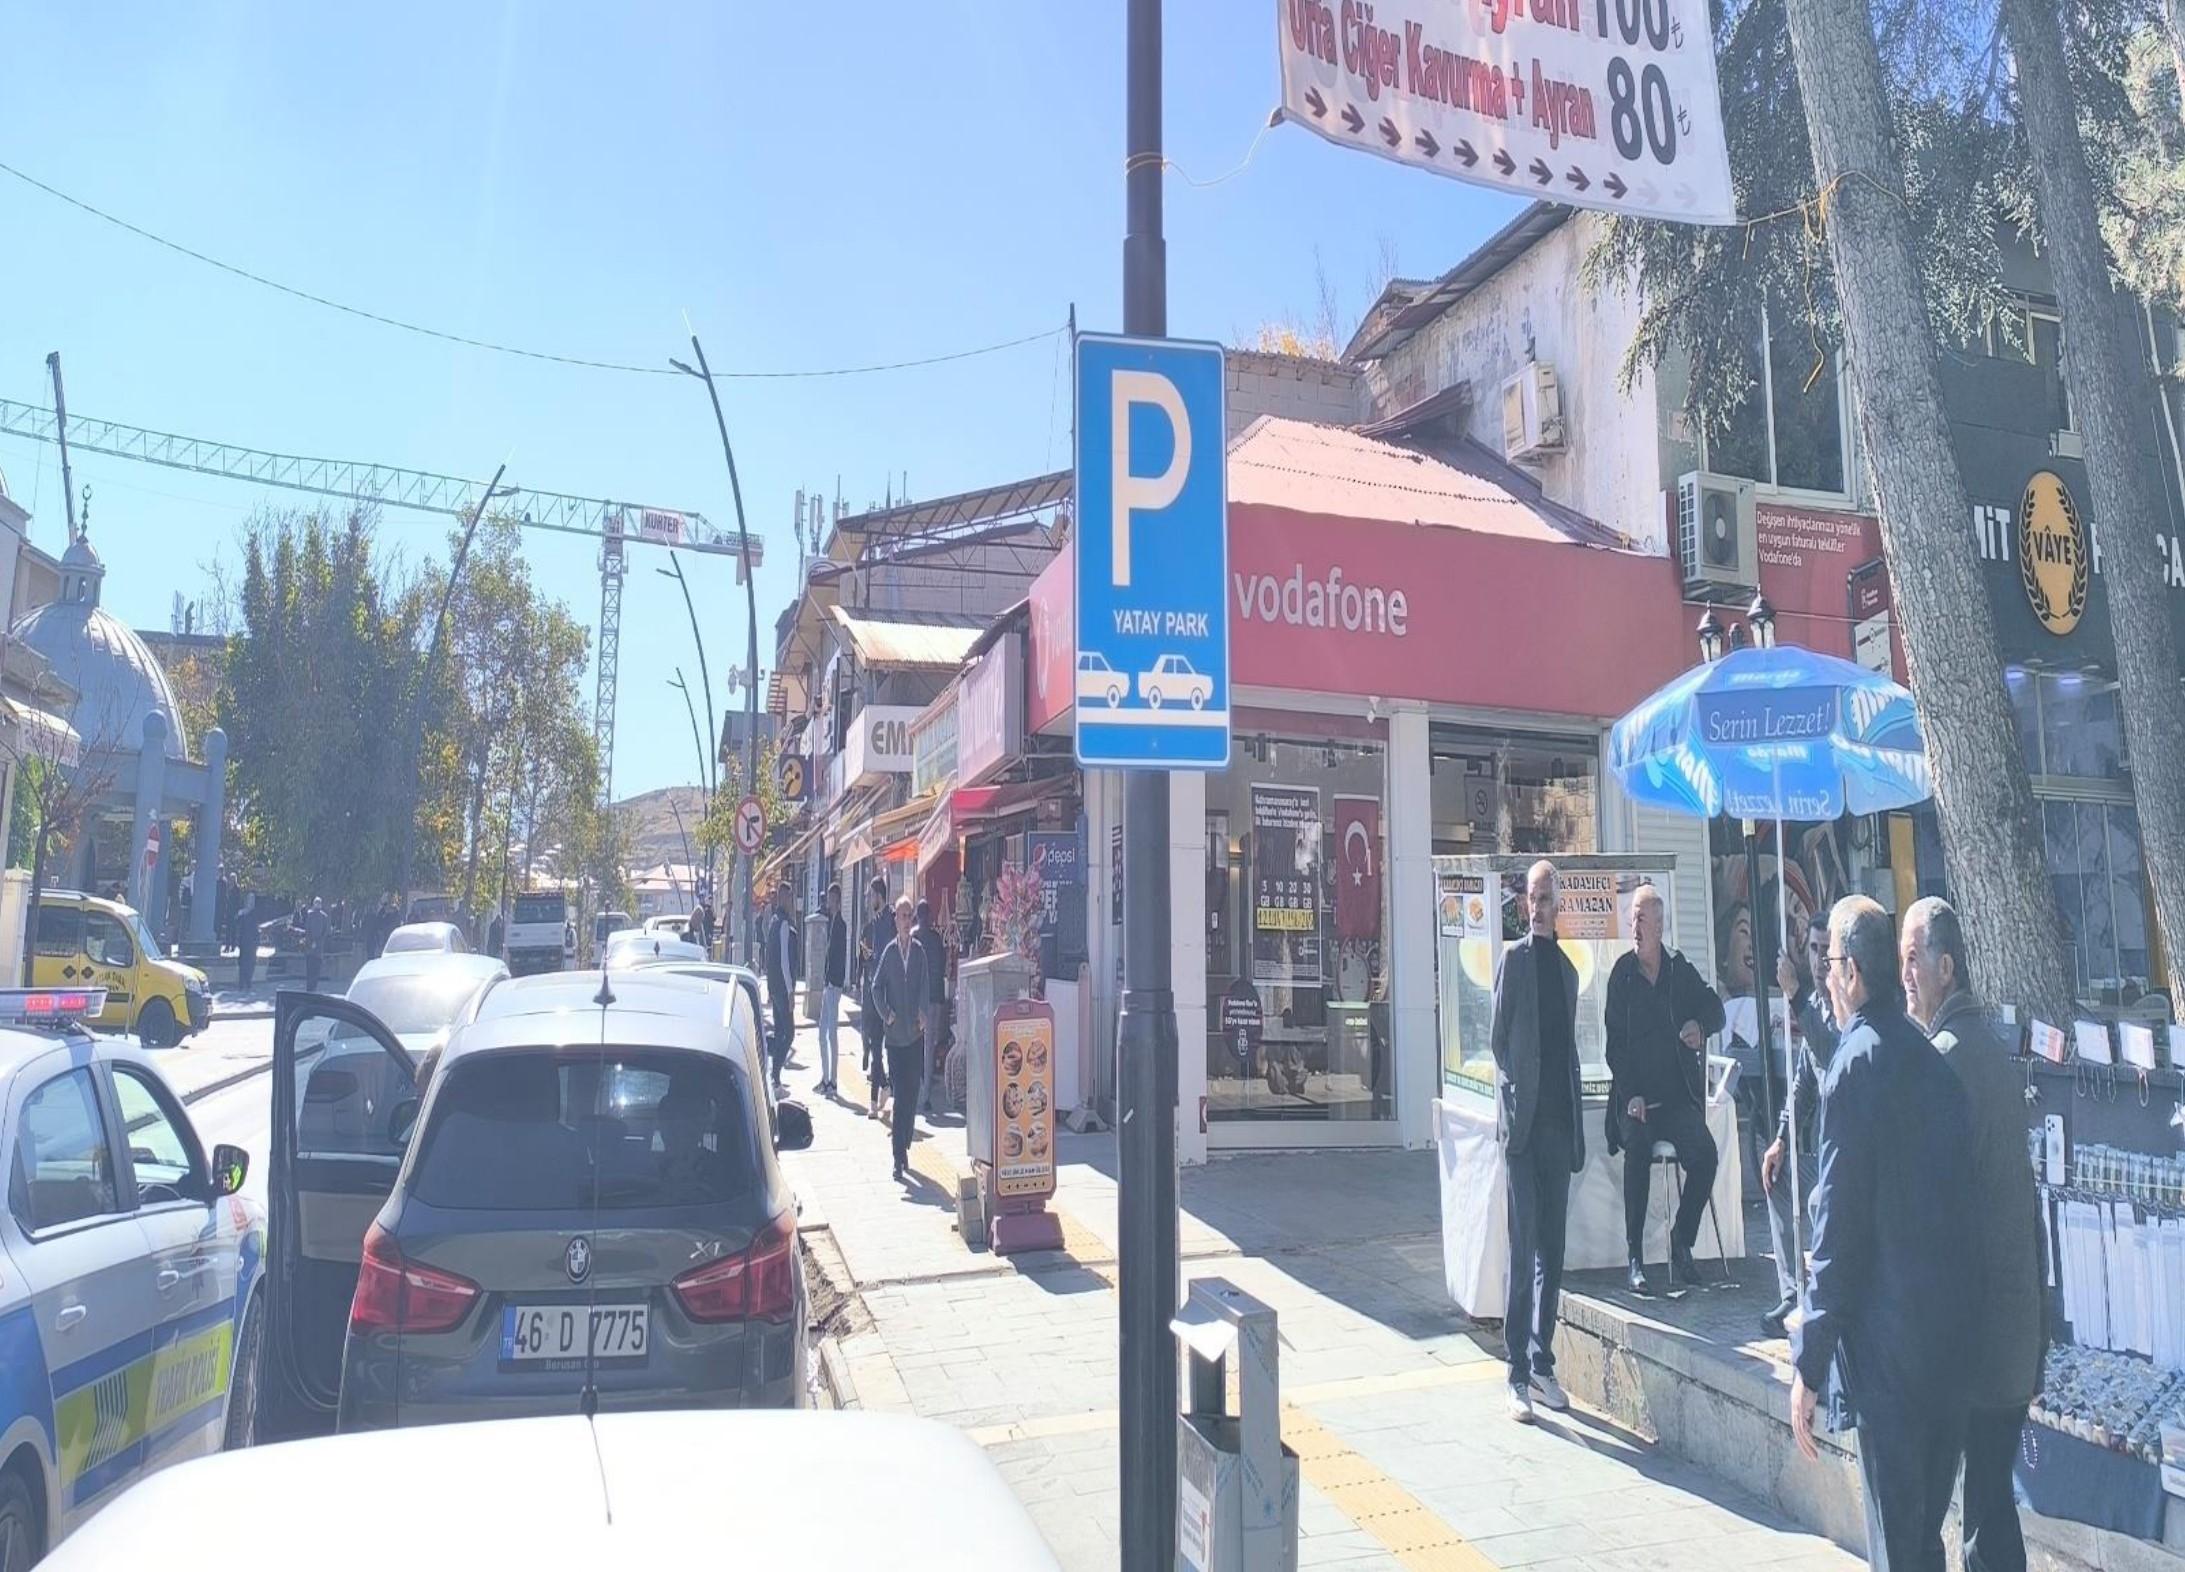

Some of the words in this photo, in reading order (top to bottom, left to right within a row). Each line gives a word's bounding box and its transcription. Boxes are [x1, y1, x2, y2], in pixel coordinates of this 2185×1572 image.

[1405, 20, 1508, 120] Kavurma
[1532, 58, 1597, 150] Ayran
[1112, 369, 1192, 586] P
[1758, 548, 1802, 566] Vodafone'da
[1769, 534, 1791, 548] uygun
[2033, 525, 2072, 565] VÂYE
[1233, 563, 1408, 636] vodafone
[1113, 609, 1160, 635] YATAY
[1166, 612, 1209, 637] PARK
[1709, 709, 1757, 741] Serin
[1764, 702, 1832, 736] Lezzet!
[1048, 847, 1075, 866] pepsi
[1559, 897, 1613, 912] RAMAZAN
[690, 1241, 721, 1258] X1
[514, 1311, 543, 1353] 46
[559, 1311, 574, 1352] D
[592, 1310, 645, 1351] 7775
